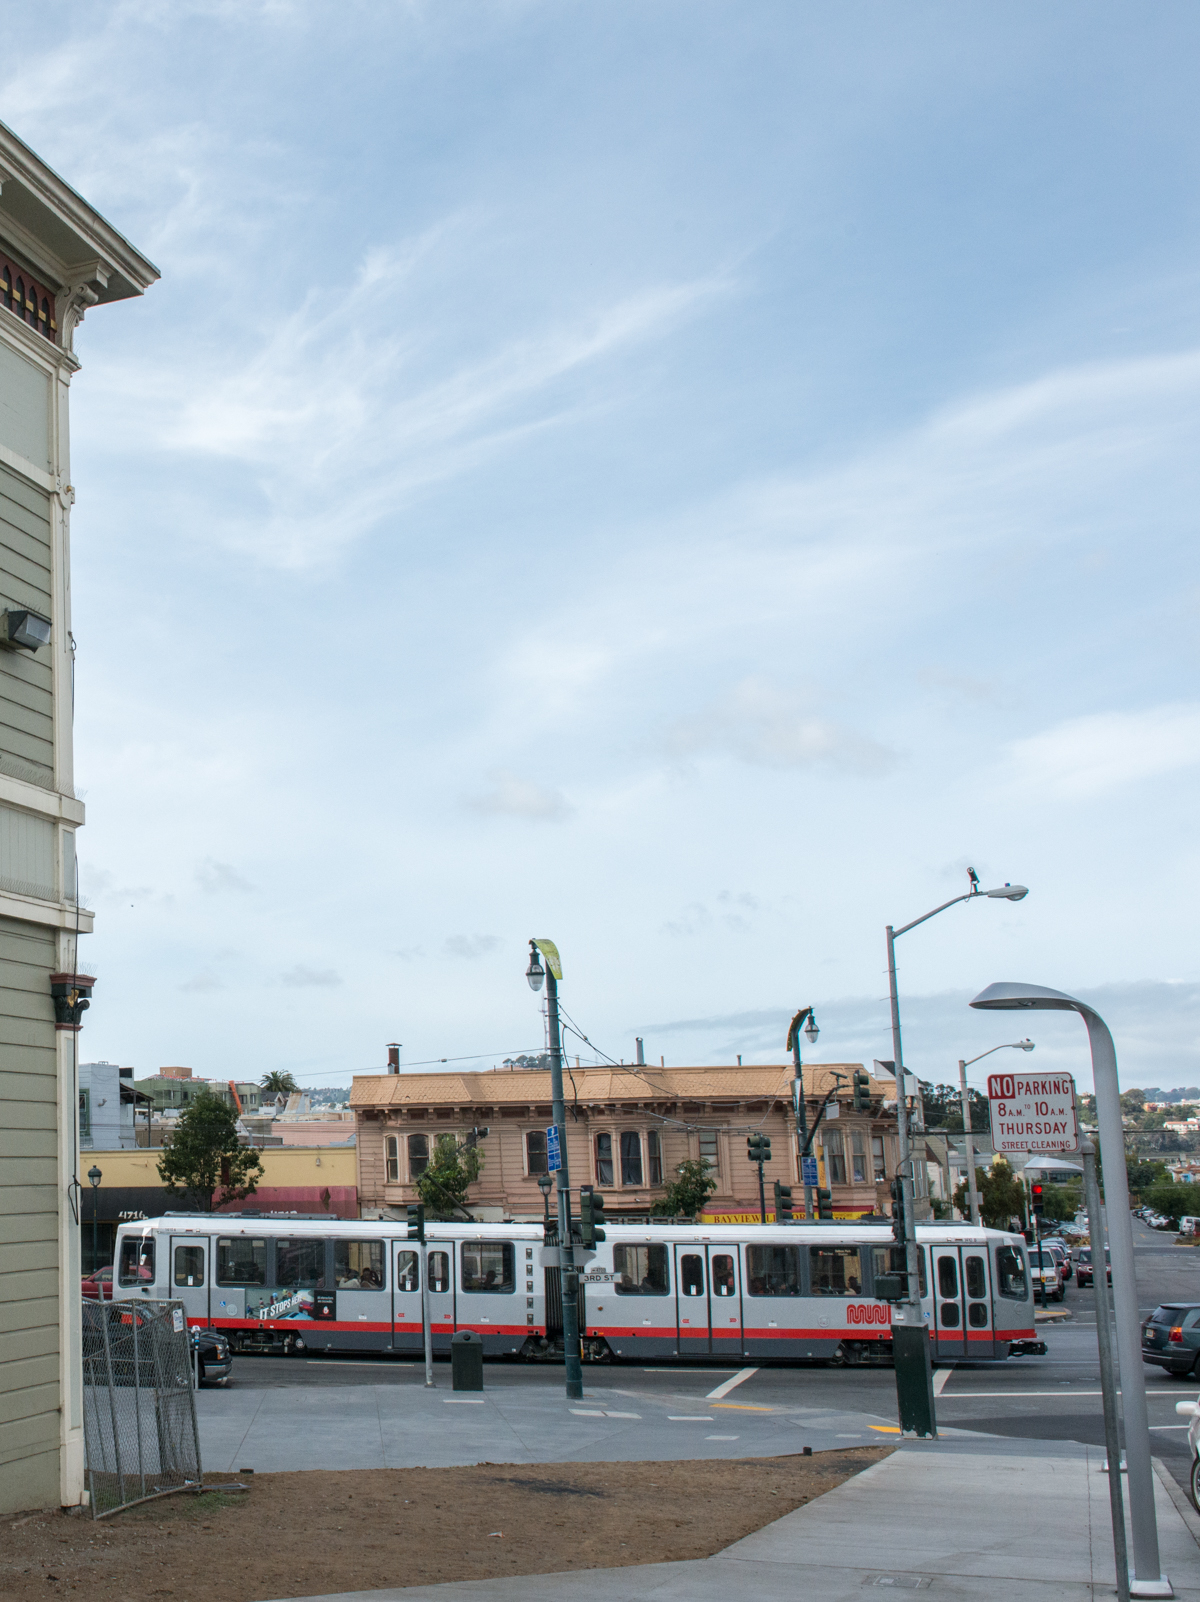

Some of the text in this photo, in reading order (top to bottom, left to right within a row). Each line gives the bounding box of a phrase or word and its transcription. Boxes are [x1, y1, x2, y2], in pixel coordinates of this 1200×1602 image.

[991, 1076, 1069, 1097] NO PARKING
[1035, 1101, 1049, 1116] 10
[1050, 1108, 1068, 1116] A.M.
[999, 1122, 1067, 1135] THURSDAY
[1002, 1140, 1071, 1150] STREET CLEANING
[714, 1213, 762, 1224] BAYVIEW
[583, 1274, 615, 1282] 3RD ST
[260, 1307, 269, 1320] IT
[270, 1299, 291, 1317] STOPS
